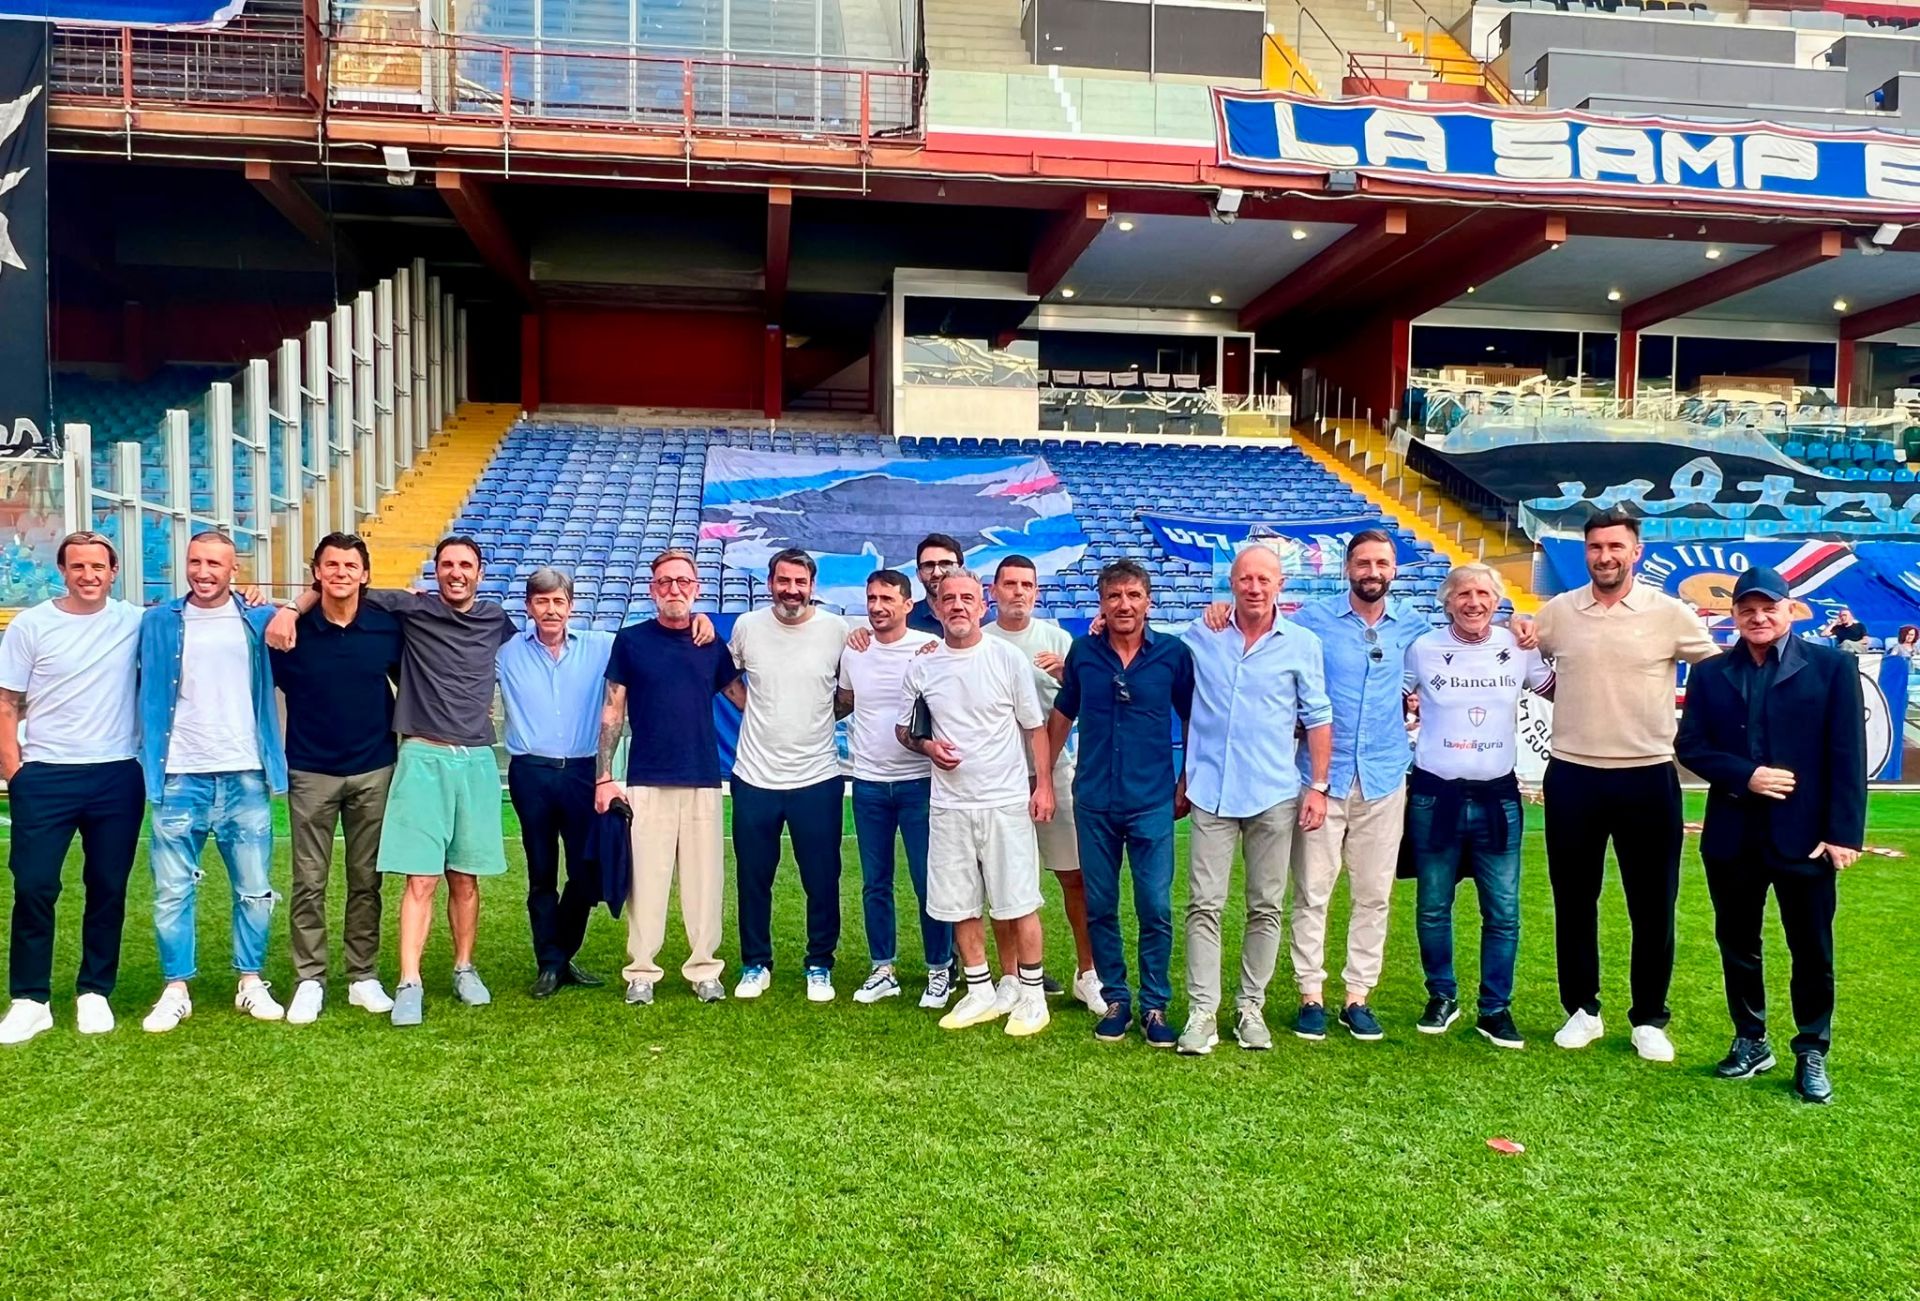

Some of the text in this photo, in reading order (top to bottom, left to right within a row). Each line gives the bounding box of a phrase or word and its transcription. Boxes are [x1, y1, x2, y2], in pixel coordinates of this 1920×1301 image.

[1274, 102, 1447, 172] LA
[1491, 120, 1818, 190] SAMP
[1450, 676, 1497, 688] Banca
